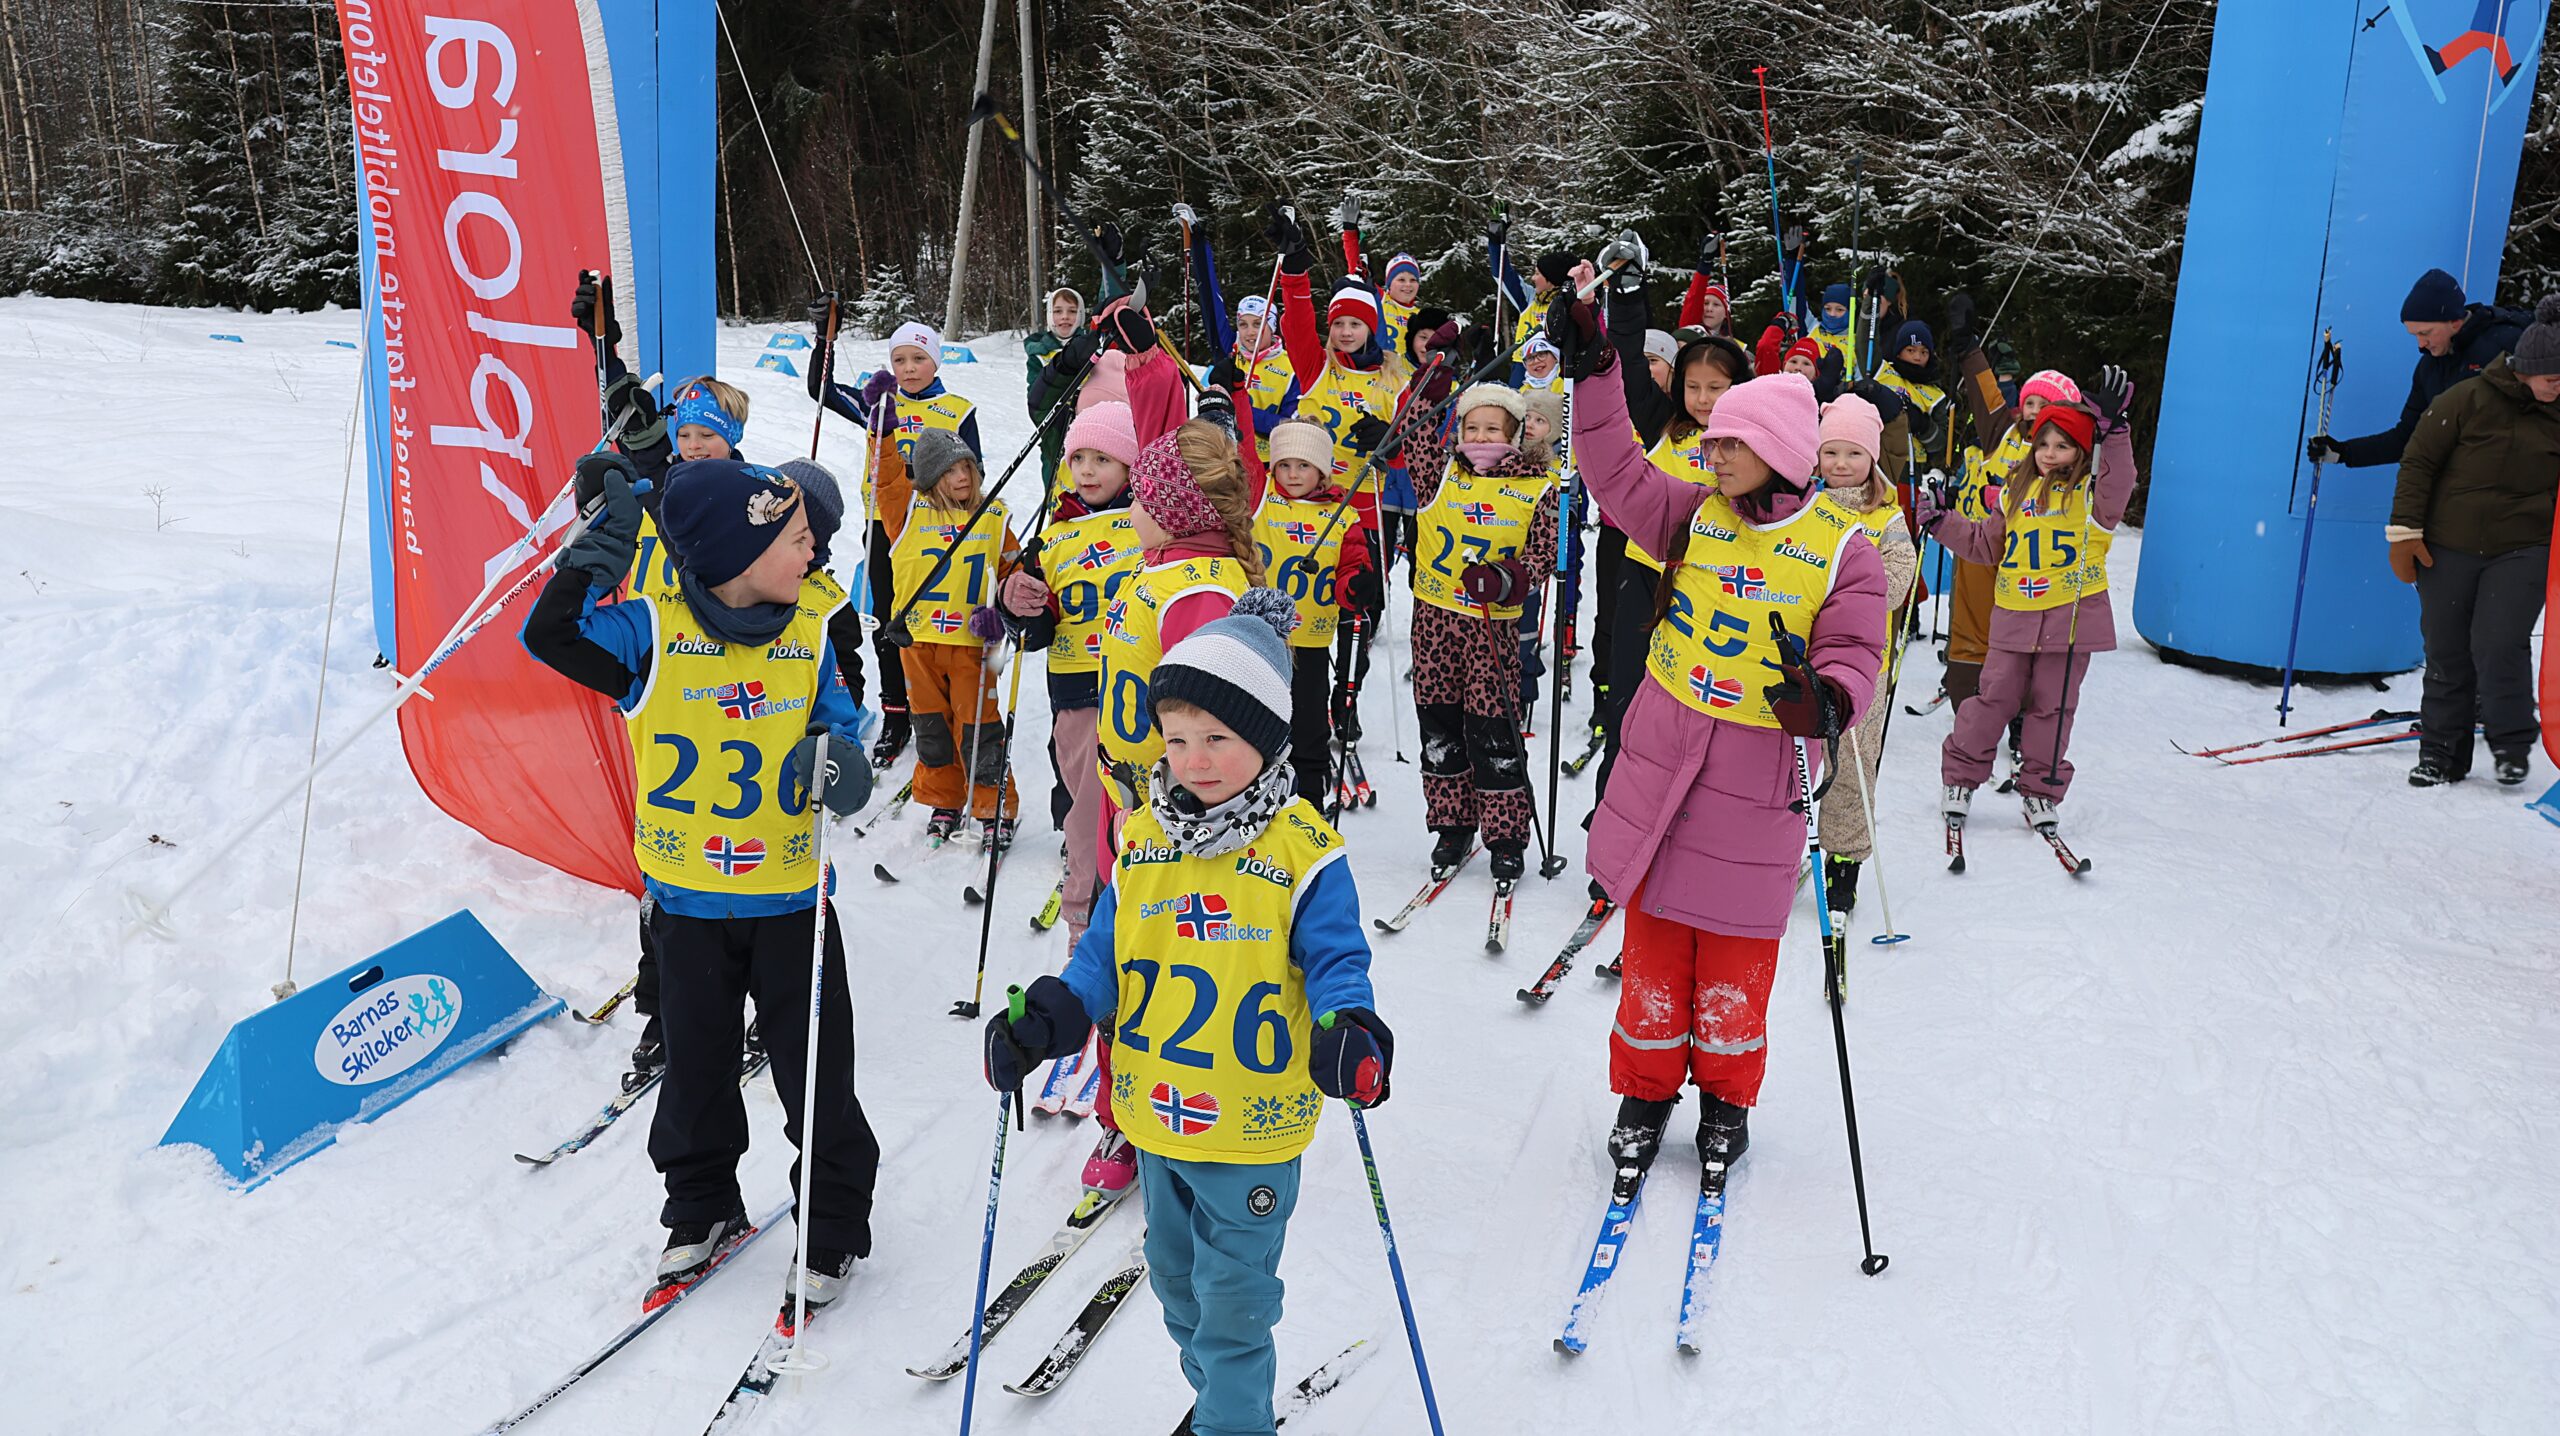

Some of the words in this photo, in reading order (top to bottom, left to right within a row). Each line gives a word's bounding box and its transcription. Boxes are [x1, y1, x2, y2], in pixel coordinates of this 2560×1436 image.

[703, 411, 726, 426] CRAFT
[927, 403, 957, 419] joker
[1560, 392, 1571, 470] SALOMON
[1500, 484, 1533, 503] joker
[1320, 509, 1348, 526] joer
[1775, 538, 1827, 568] joker
[2000, 528, 2078, 570] 215
[1746, 588, 1802, 605] skileker
[668, 633, 724, 659] joker
[767, 638, 813, 662] joke
[683, 683, 735, 701] Barnas
[753, 696, 807, 719] skileker
[1795, 744, 1814, 827] SALOMON
[1125, 839, 1181, 871] joker
[1140, 895, 1189, 919] Barnas
[1209, 923, 1273, 942] skileker
[331, 990, 400, 1049] Barnas
[1119, 958, 1293, 1075] 226
[341, 1015, 413, 1084] Skileker
